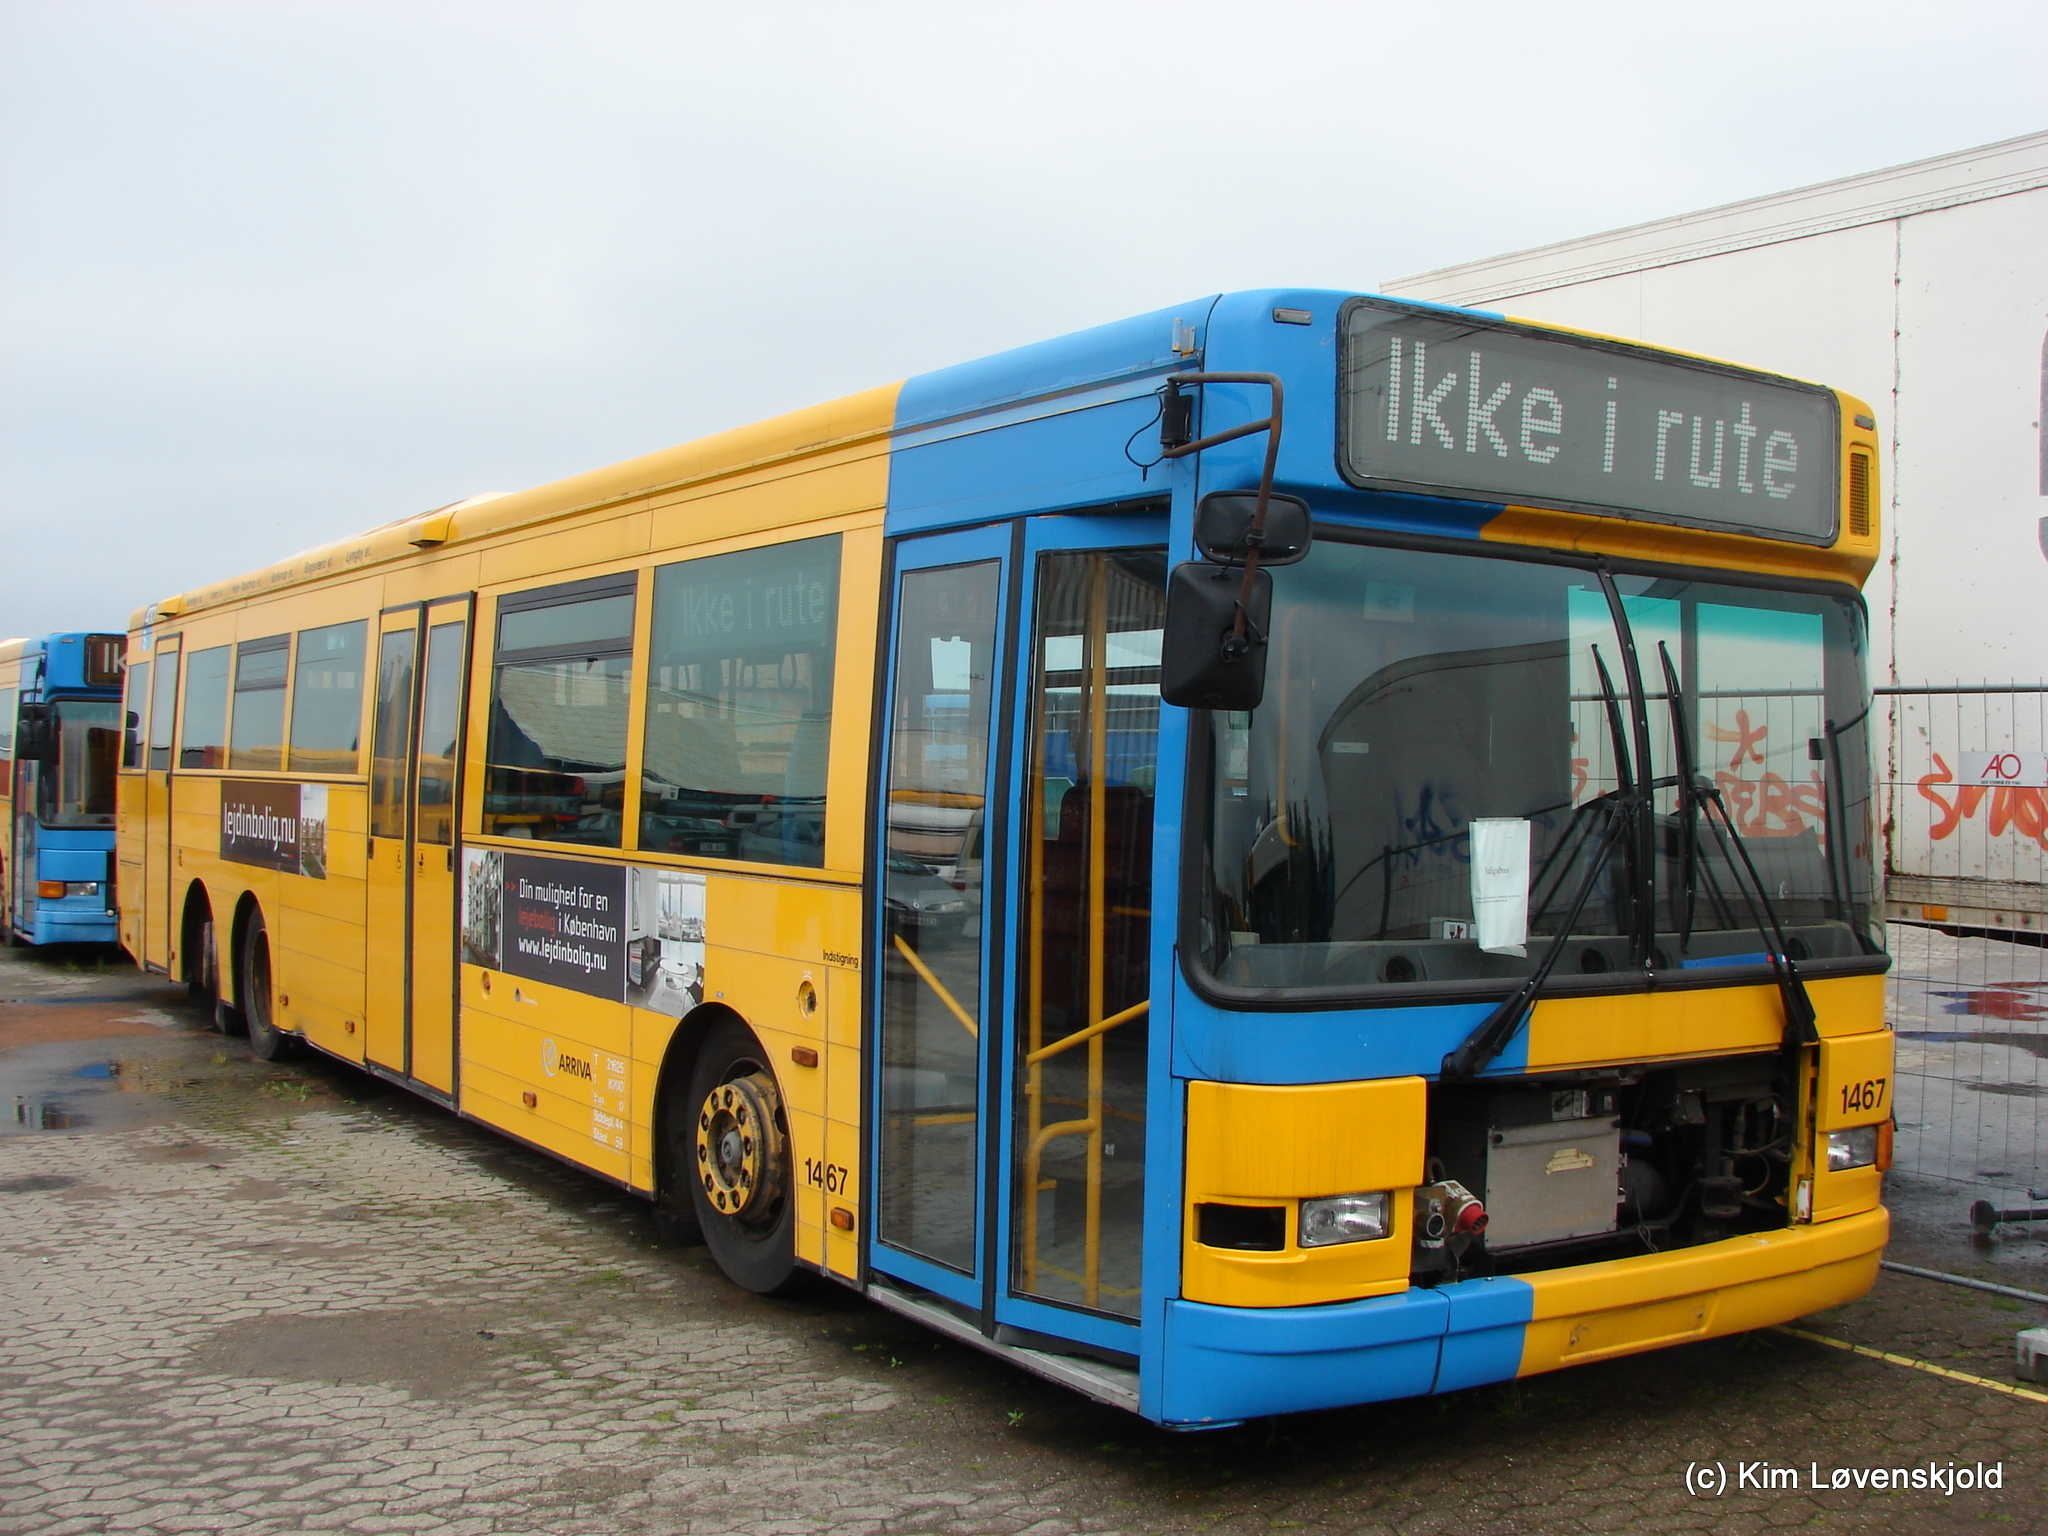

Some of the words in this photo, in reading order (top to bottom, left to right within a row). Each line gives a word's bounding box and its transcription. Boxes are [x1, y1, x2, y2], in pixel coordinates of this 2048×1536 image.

[1386, 337, 1562, 464] Ikke
[1603, 376, 1618, 474] i
[1654, 402, 1798, 499] rute
[683, 584, 735, 636] Ikke
[747, 578, 753, 630] i
[765, 571, 824, 628] rute
[1980, 753, 2022, 780] AO
[224, 802, 296, 852] lejdinbolig.nu
[519, 877, 533, 900] Din
[535, 881, 577, 911] mulighed
[578, 886, 594, 908] for
[595, 894, 609, 912] en
[517, 906, 557, 937] lejebolig
[564, 912, 617, 943] København
[518, 936, 607, 973] www.lejdinbolig.nu
[822, 949, 859, 968] Indstigning
[559, 1054, 592, 1081] ARRIVA
[1842, 1078, 1886, 1114] 1467
[805, 1157, 848, 1196] 1467
